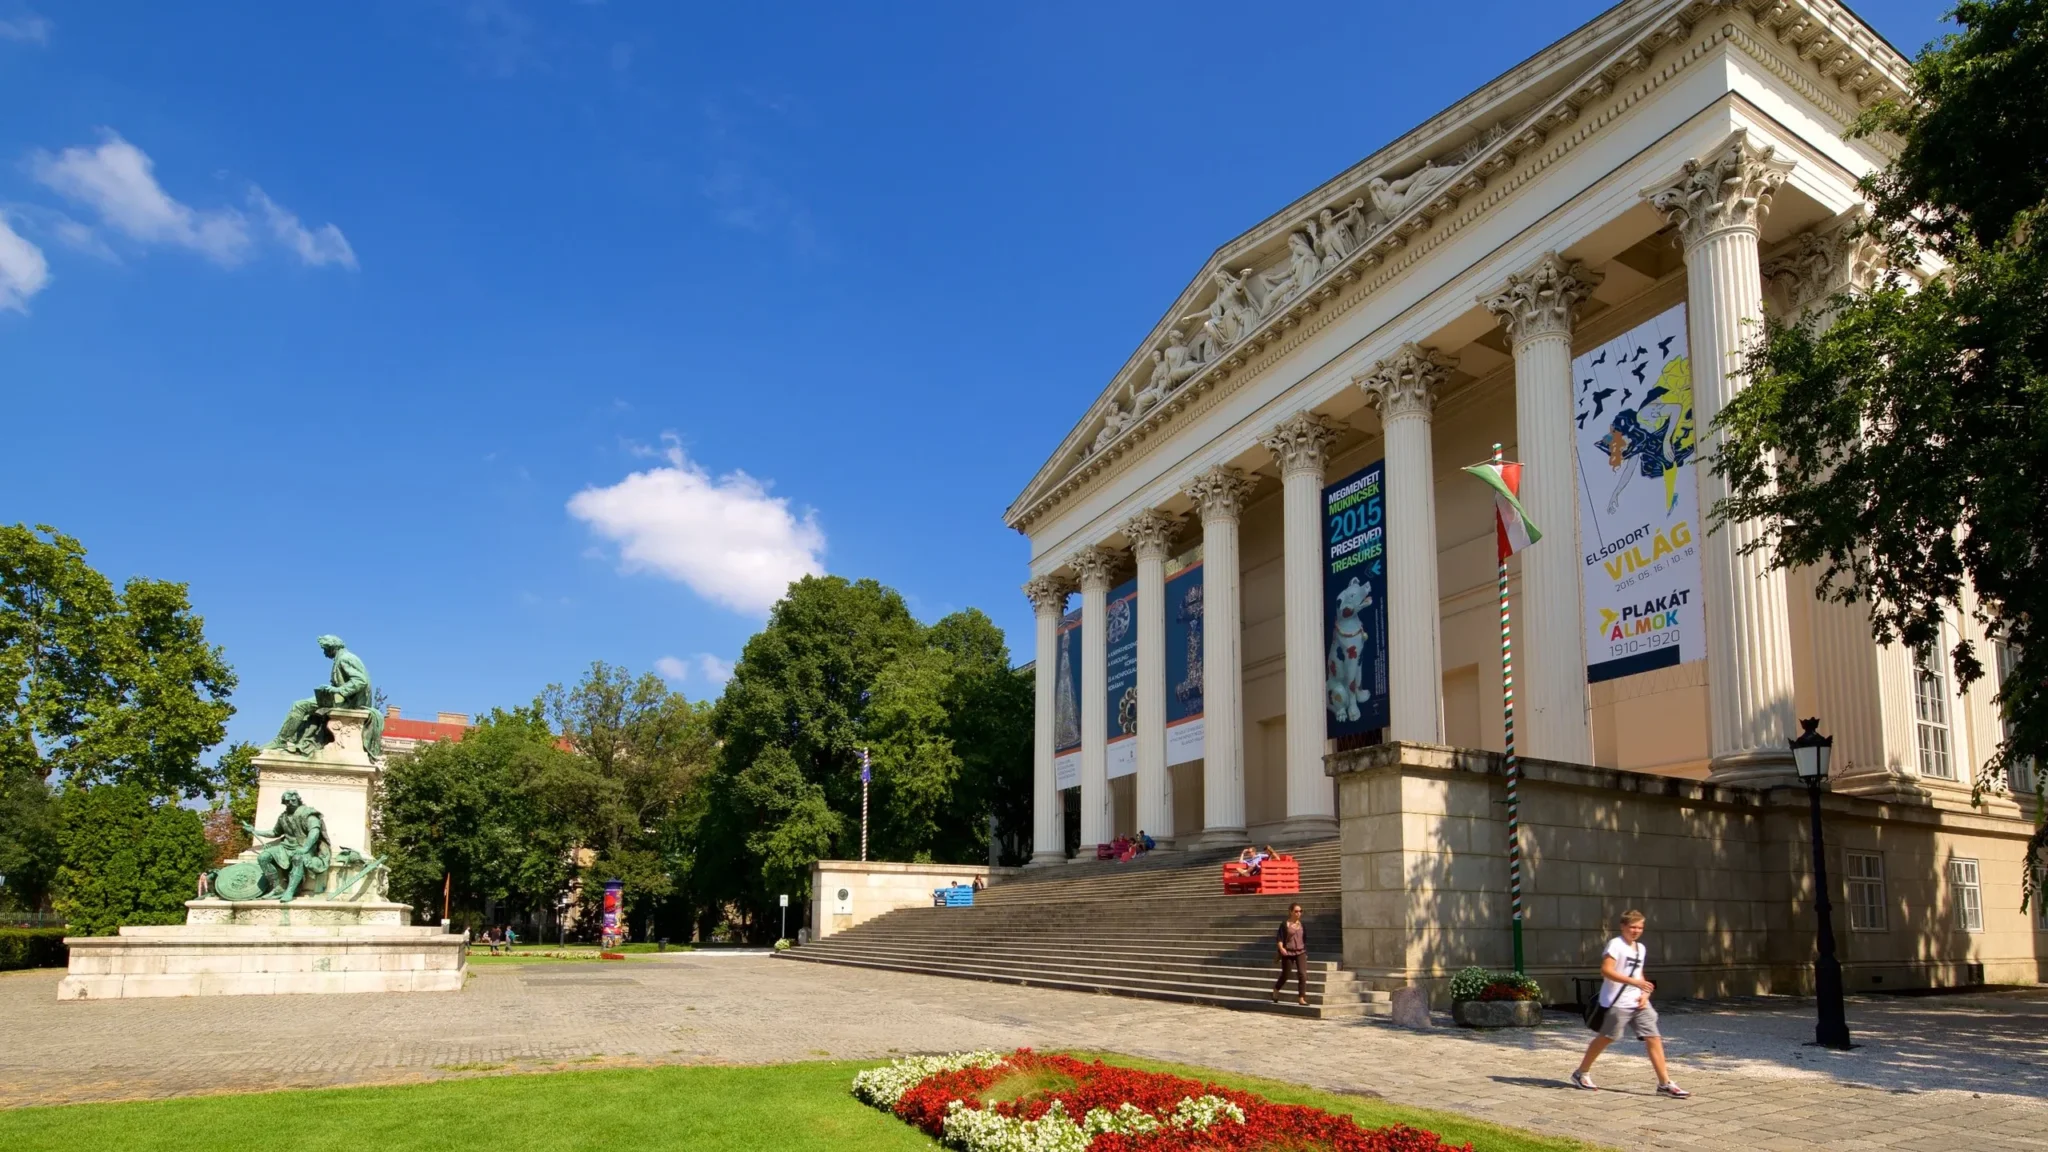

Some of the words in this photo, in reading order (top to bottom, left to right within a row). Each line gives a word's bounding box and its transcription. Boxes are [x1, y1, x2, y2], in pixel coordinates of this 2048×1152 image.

[1328, 470, 1380, 504] MEGMENTETT
[1331, 496, 1382, 544] 2015
[1331, 526, 1382, 558] PRESERVED
[1331, 544, 1382, 574] TREASURES
[1585, 523, 1651, 566] ELSODORT
[1603, 521, 1692, 581] VILÁG
[1615, 578, 1636, 592] 2015.
[1638, 570, 1652, 581] 05.
[1672, 554, 1683, 563] 10.
[1622, 589, 1691, 621] PLAKÁT
[1610, 609, 1679, 642] ÁLMOK
